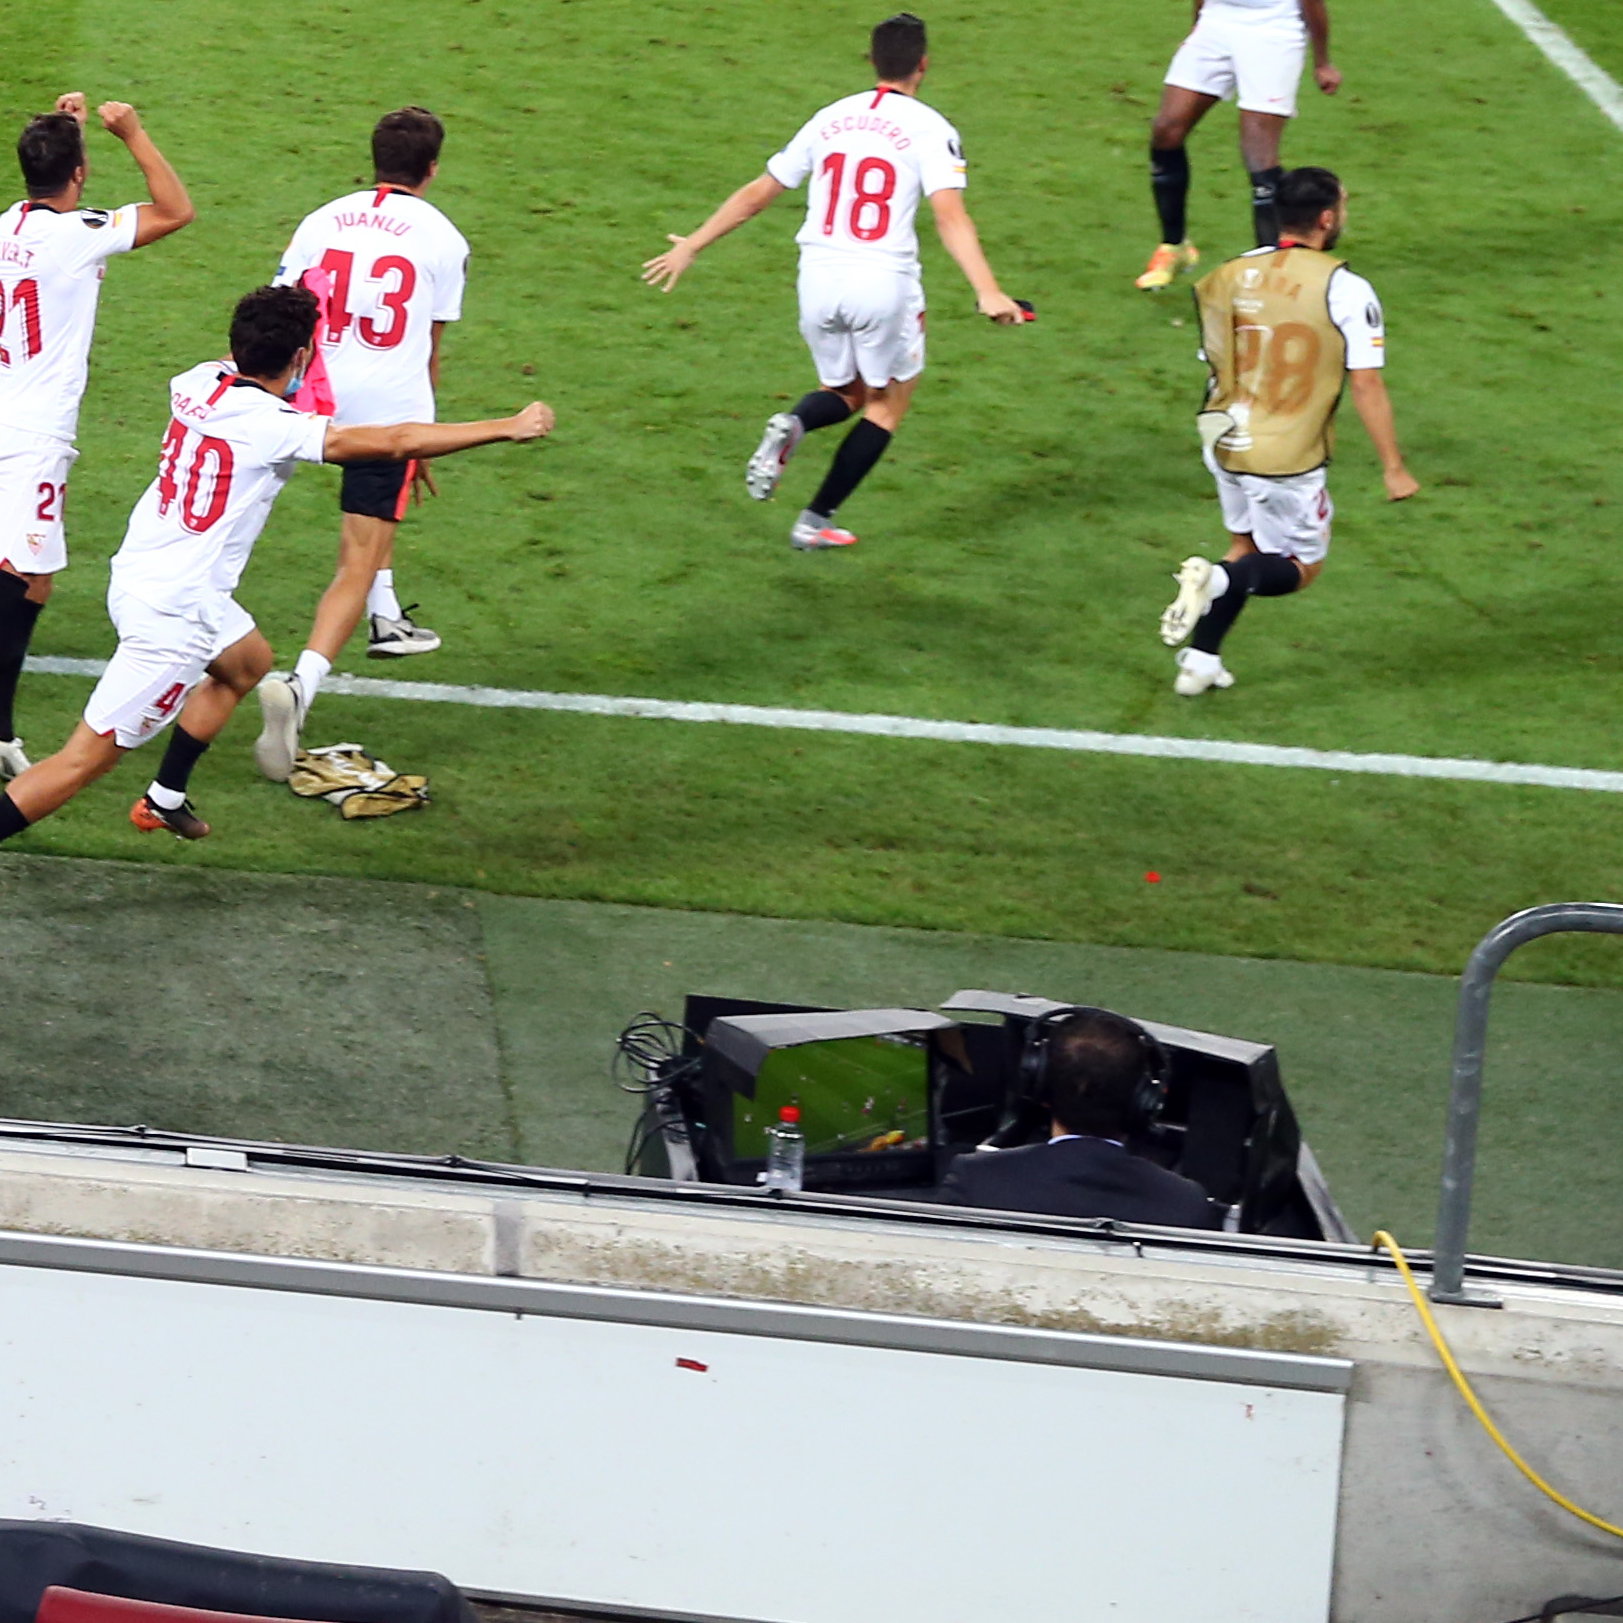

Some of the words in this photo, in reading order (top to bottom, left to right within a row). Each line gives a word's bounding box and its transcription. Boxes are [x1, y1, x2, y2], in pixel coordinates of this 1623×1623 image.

[820, 115, 912, 152] ESCUDERO
[819, 151, 897, 242] 18
[332, 212, 412, 239] JUANLU
